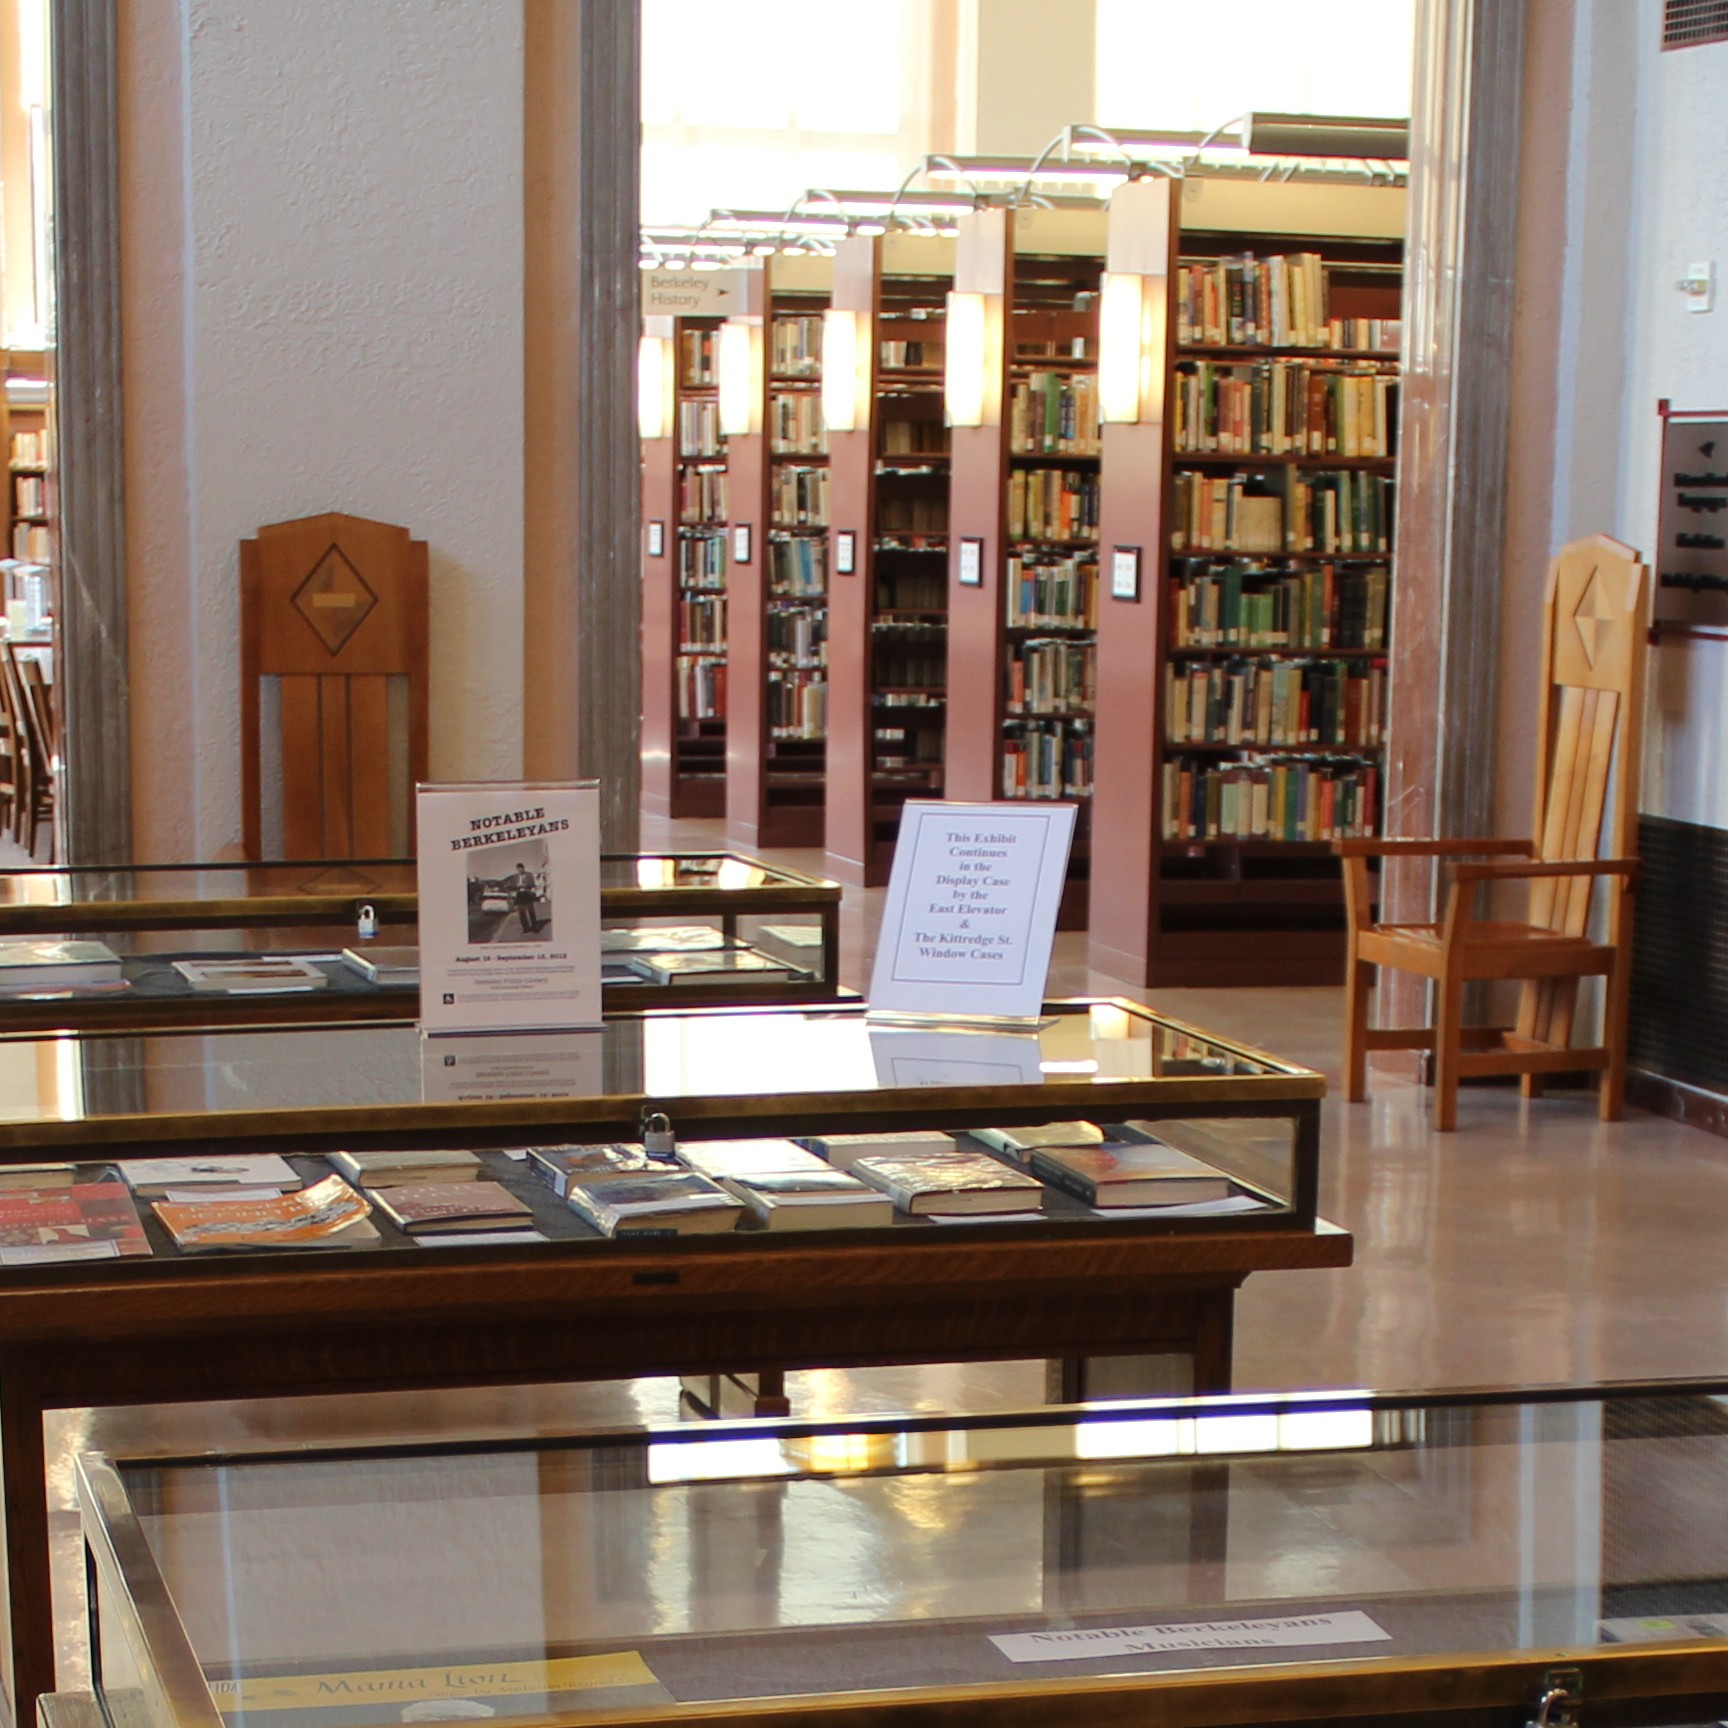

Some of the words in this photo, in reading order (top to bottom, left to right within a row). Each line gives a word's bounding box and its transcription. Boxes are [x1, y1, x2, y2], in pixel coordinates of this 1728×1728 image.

[651, 275, 710, 291] Berkeley
[651, 293, 701, 308] History
[469, 807, 545, 831] NOTABLE
[450, 819, 570, 850] BERKELEYANS
[947, 832, 971, 843] This
[974, 832, 1017, 844] Exhibit
[949, 846, 1008, 858] Continues
[959, 861, 971, 871] in
[973, 861, 993, 872] the
[936, 874, 979, 888] Display
[982, 875, 1011, 887] Case
[953, 889, 967, 901] by
[970, 890, 989, 900] the
[929, 902, 955, 914] East
[958, 903, 1008, 915] Elevator
[959, 918, 971, 929] &
[914, 931, 937, 944] The
[939, 932, 994, 947] Kittredge
[997, 934, 1015, 946] St.
[918, 946, 967, 959] Window
[970, 947, 1004, 960] Cases
[1030, 1627, 1145, 1645] Notable
[1153, 1617, 1333, 1637] Berkeleyans
[1124, 1637, 1276, 1653] Musicians
[315, 1677, 428, 1696] Mama
[444, 1670, 524, 1690] Lion
